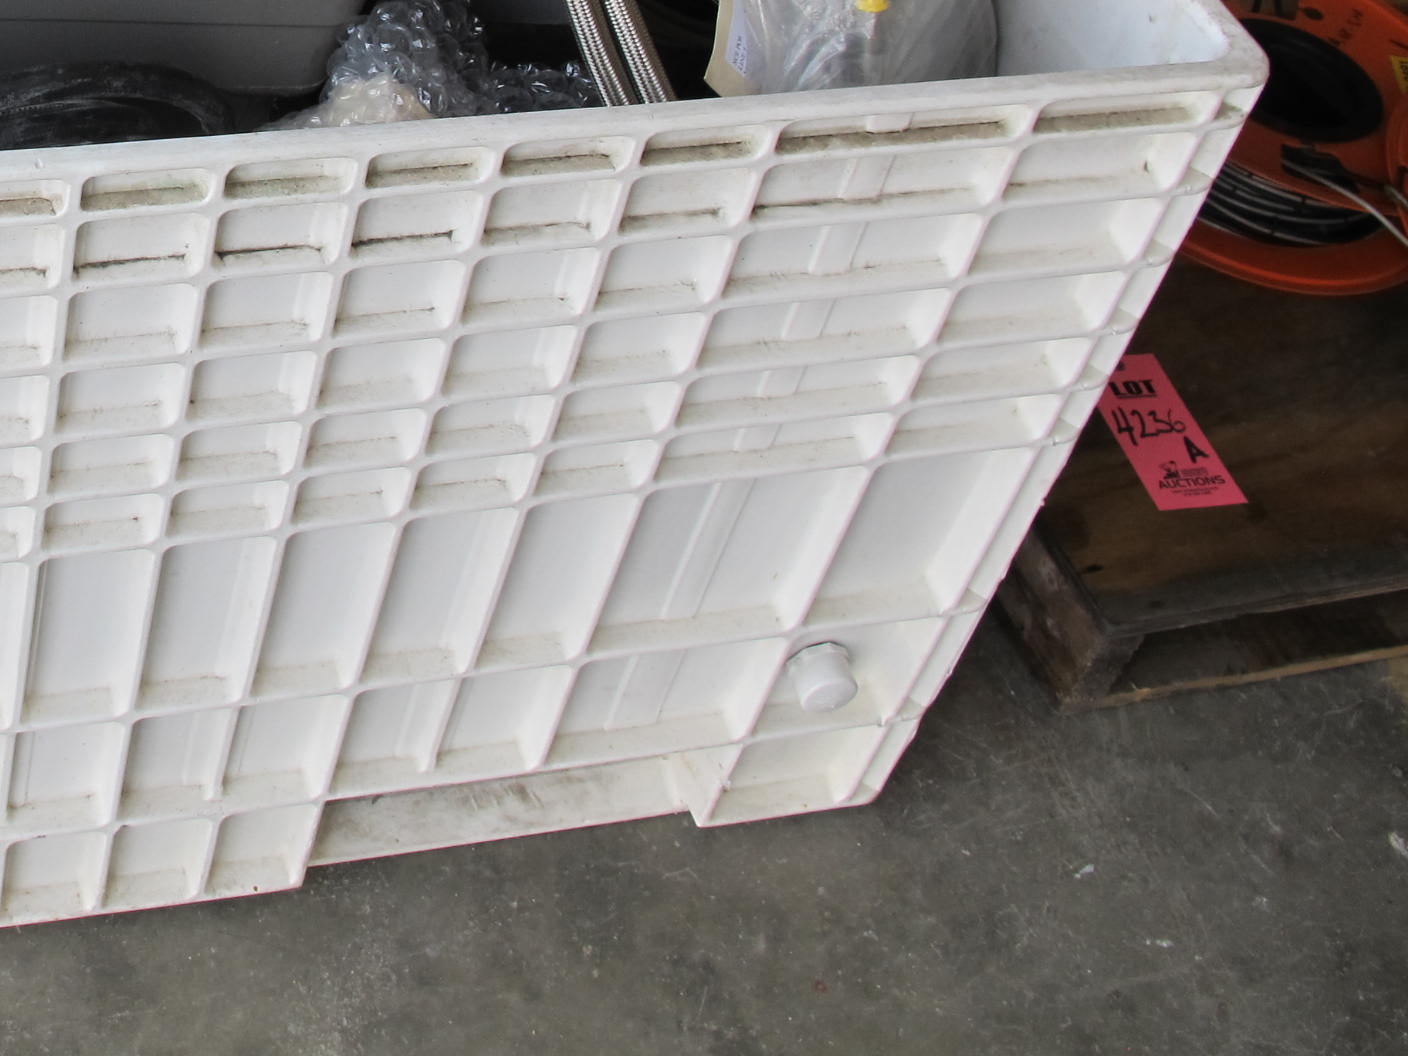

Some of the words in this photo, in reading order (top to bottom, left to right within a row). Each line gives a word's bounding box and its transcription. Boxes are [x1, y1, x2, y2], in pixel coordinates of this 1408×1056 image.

[1108, 379, 1156, 396] LOT
[1111, 407, 1186, 446] 4236
[1183, 436, 1209, 463] A
[1158, 475, 1226, 490] AUCTIONS
